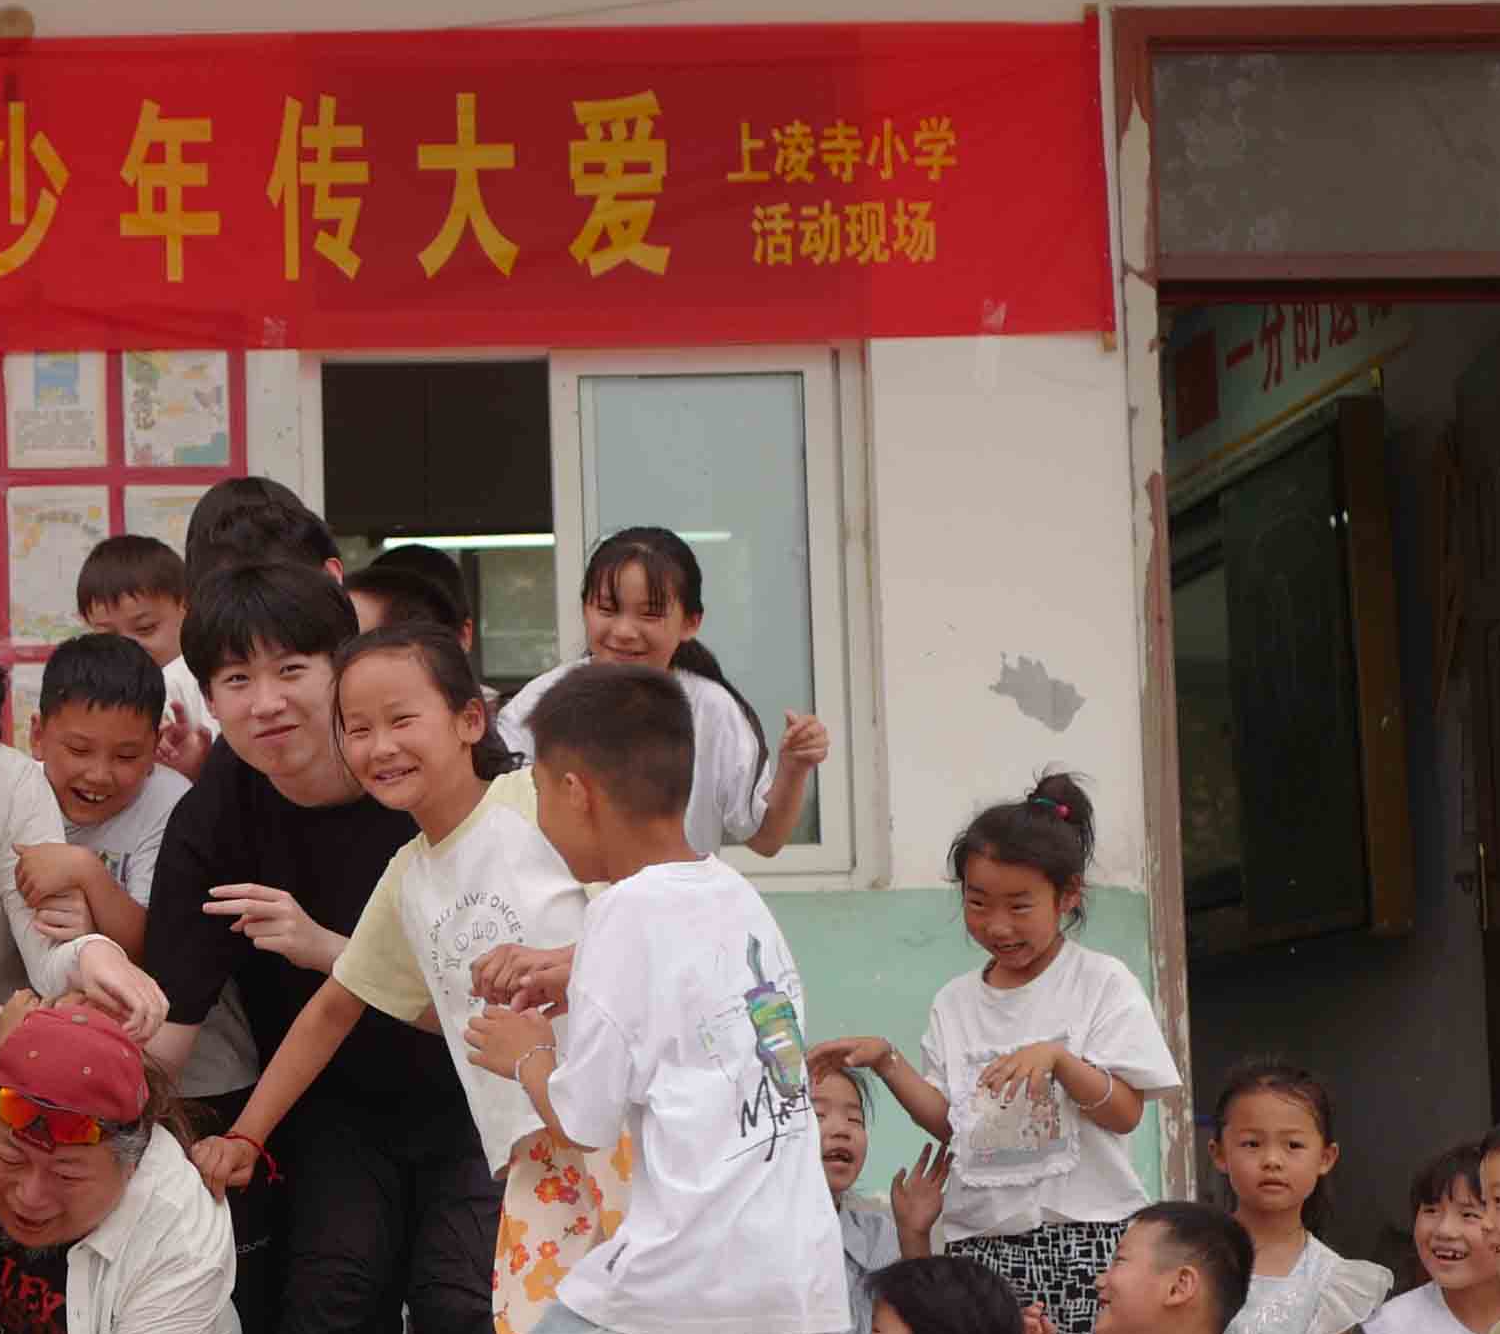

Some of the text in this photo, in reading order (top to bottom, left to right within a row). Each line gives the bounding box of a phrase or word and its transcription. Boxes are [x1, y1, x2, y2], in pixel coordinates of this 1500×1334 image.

[726, 117, 957, 183] 上凌寺小学
[751, 199, 938, 266] 活动现场
[455, 890, 488, 910] LIVE
[489, 893, 522, 934] ONCE
